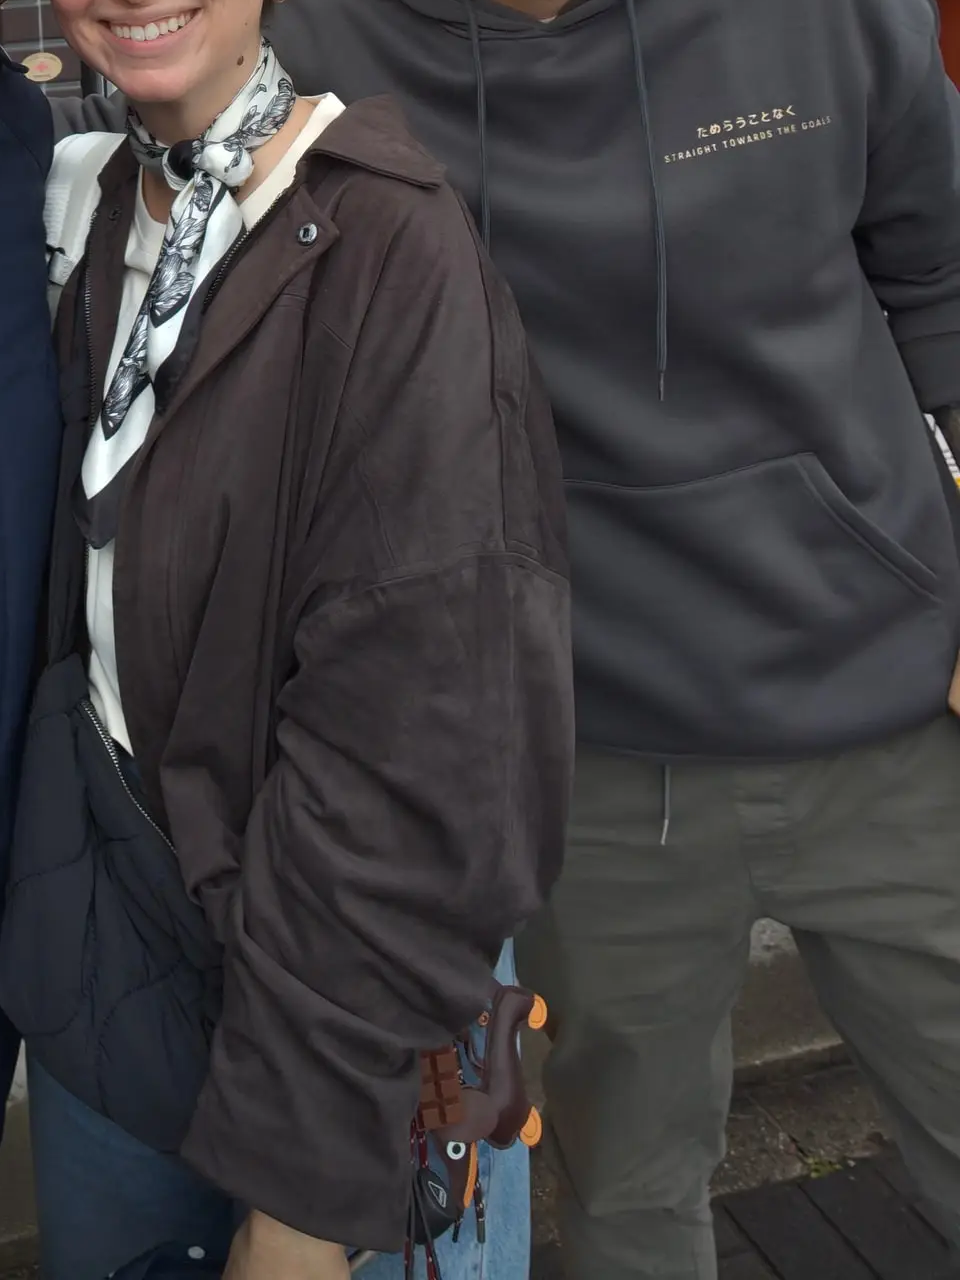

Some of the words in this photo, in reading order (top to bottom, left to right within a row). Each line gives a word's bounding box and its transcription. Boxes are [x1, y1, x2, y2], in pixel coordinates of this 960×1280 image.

[664, 143, 717, 164] STRAIGHT
[722, 130, 773, 149] TOWARDS
[777, 124, 797, 136] THE
[801, 116, 831, 130] GOALS
[696, 105, 796, 139] ためらうことなく
